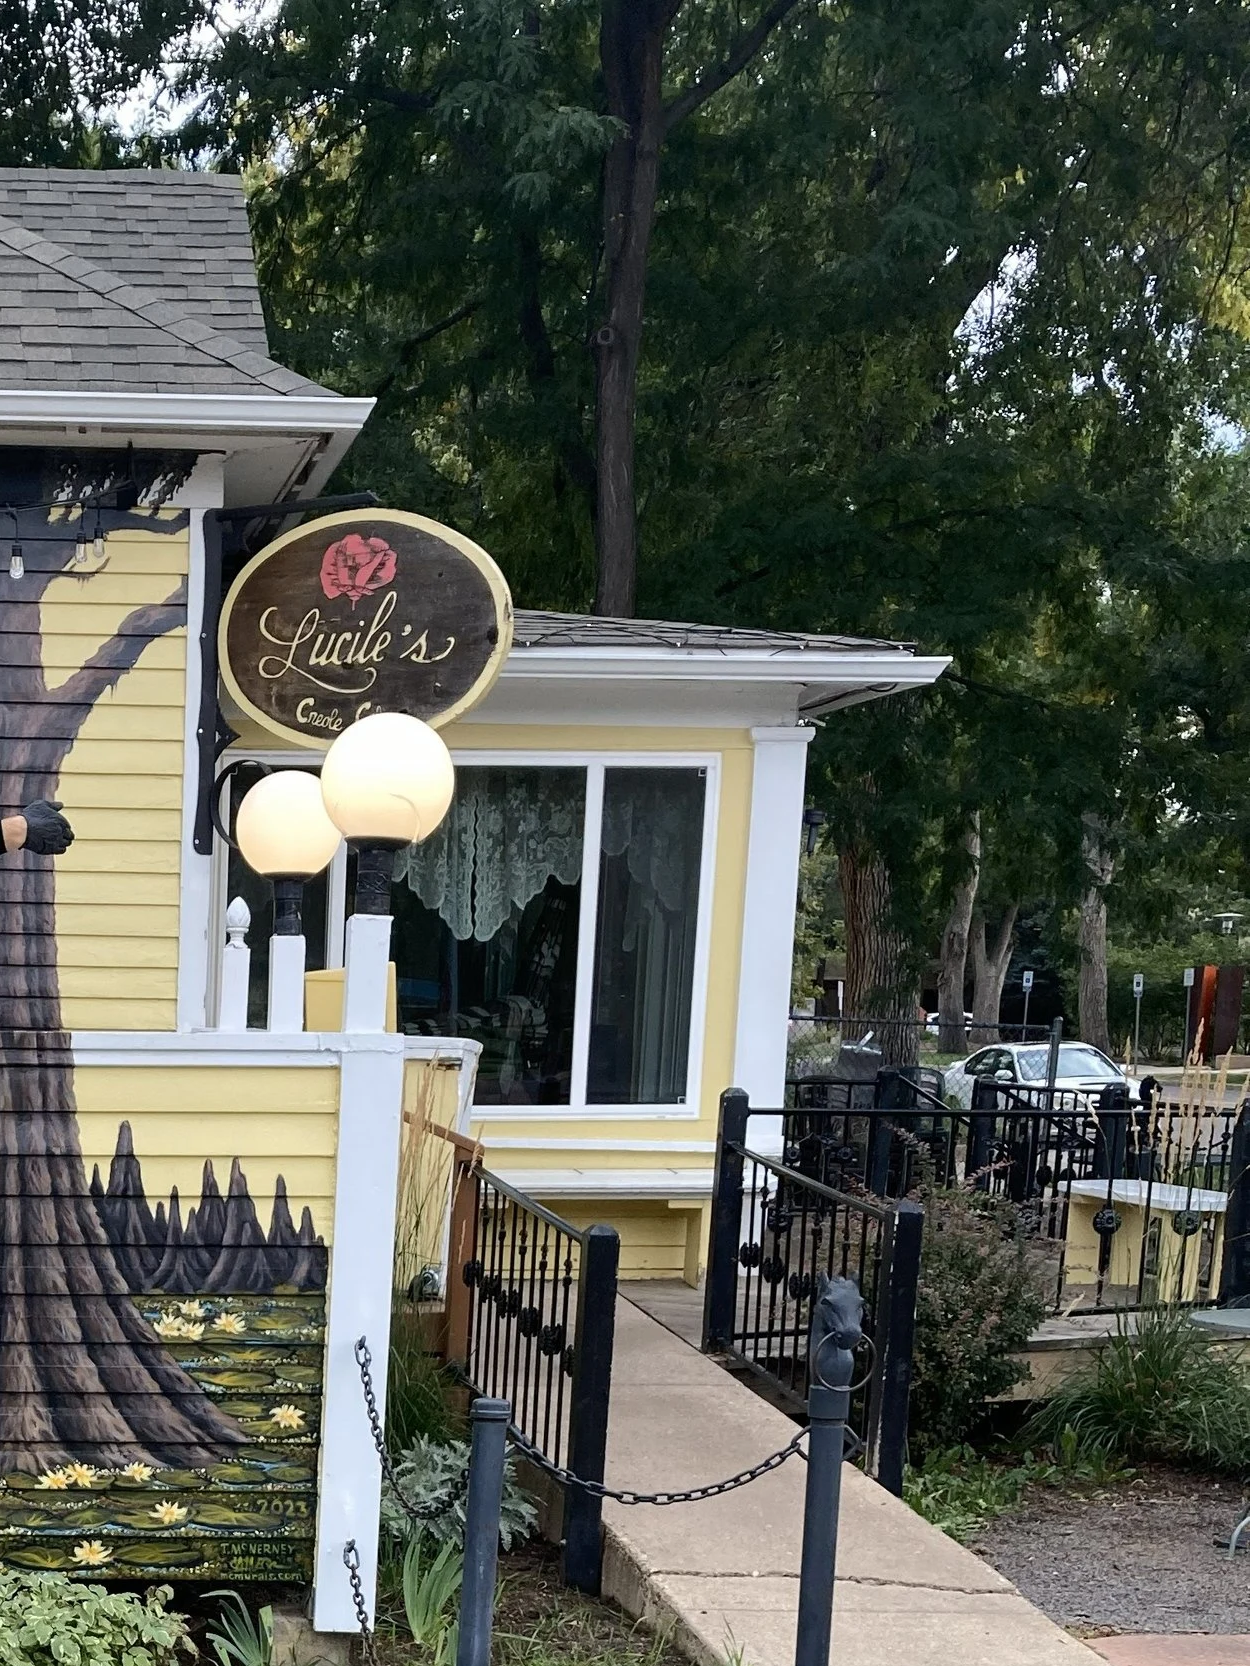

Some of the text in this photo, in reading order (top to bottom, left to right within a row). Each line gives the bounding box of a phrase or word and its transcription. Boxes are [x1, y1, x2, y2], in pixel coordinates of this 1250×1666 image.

[259, 591, 455, 693] Lucile's
[296, 698, 344, 731] Creole
[257, 1498, 309, 1518] 2023
